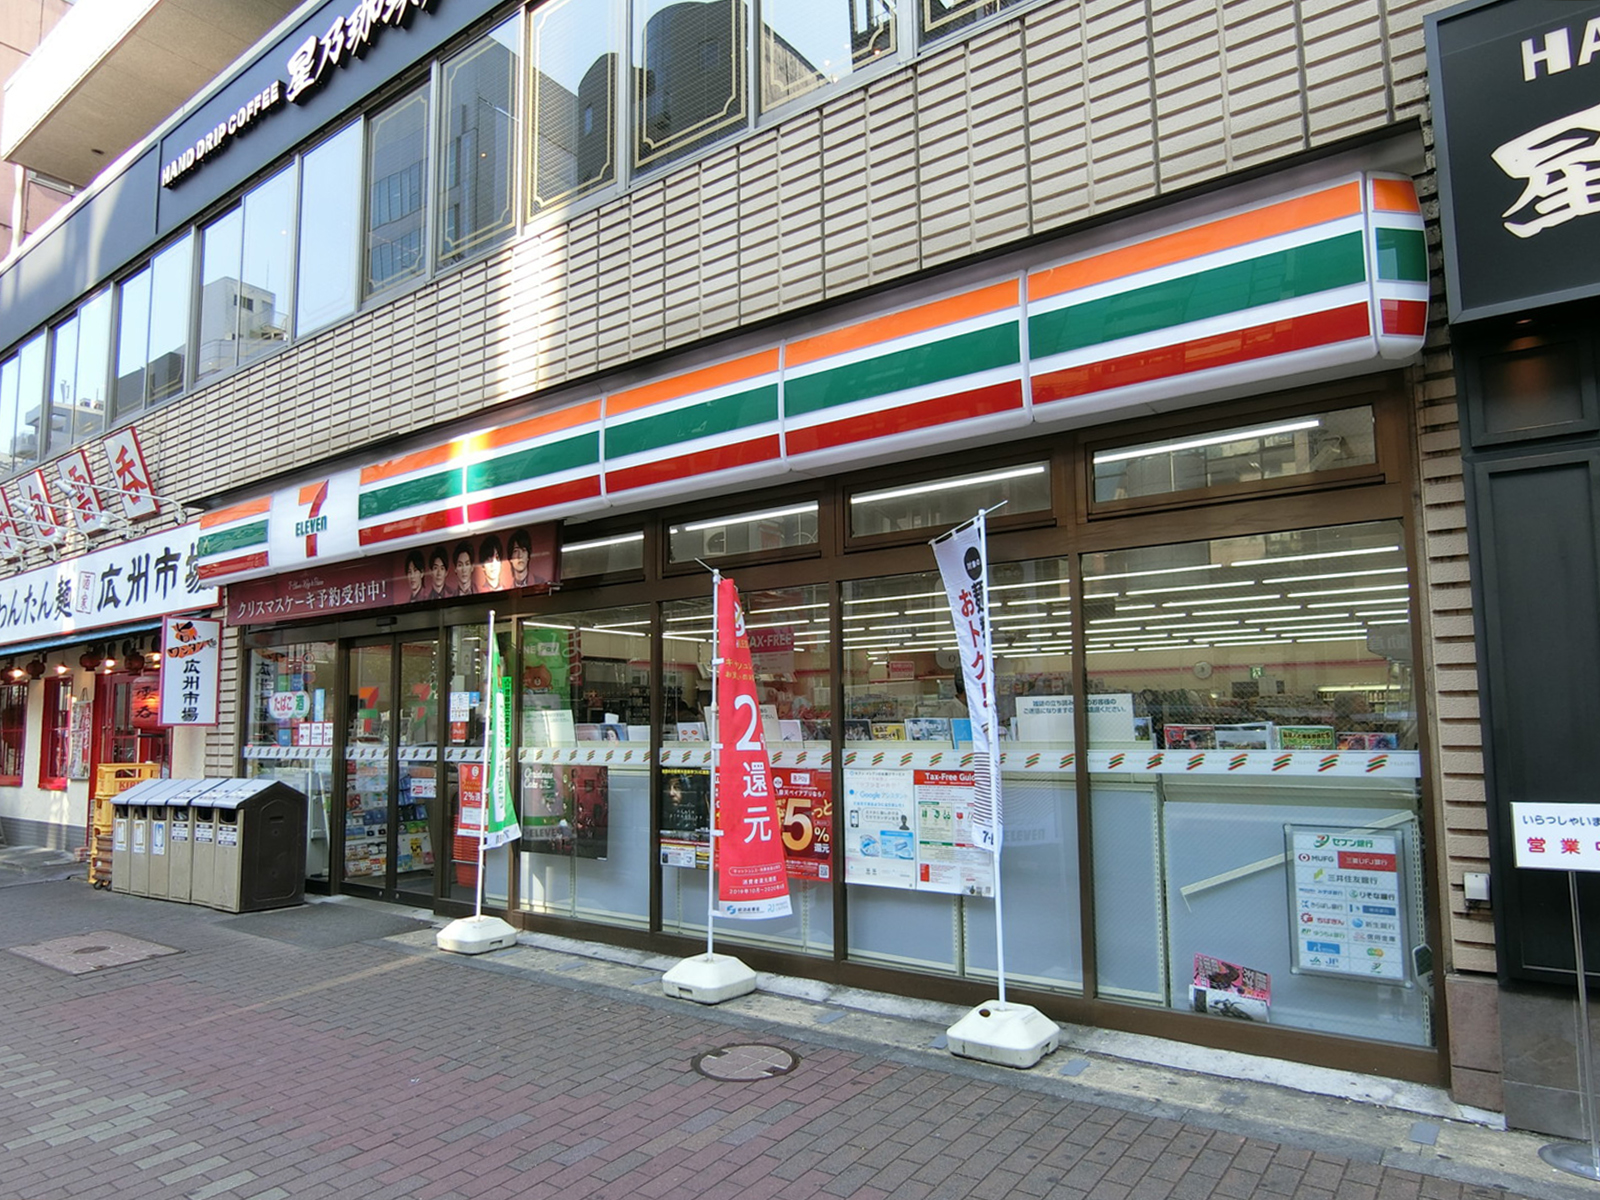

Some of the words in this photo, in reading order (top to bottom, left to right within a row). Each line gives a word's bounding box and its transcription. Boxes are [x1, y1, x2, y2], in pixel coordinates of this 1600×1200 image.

[287, 0, 426, 103] 星乃珈
[162, 147, 196, 187] HAND
[195, 124, 227, 161] DRIP
[227, 79, 280, 136] COFFEE
[181, 658, 201, 722] 広州市場
[273, 695, 292, 711] たばこ
[295, 694, 304, 711] 酒
[924, 772, 958, 781] Tax-Free
[959, 773, 975, 782] Guid
[743, 761, 772, 844] 還元
[782, 798, 813, 851] 5
[814, 826, 830, 842] %
[1332, 837, 1374, 849] セブン銀行
[1527, 836, 1600, 855] 営業
[1311, 855, 1334, 863] MUFG
[1327, 873, 1378, 885] 三井住友銀行
[1359, 891, 1395, 901] りそな銀行
